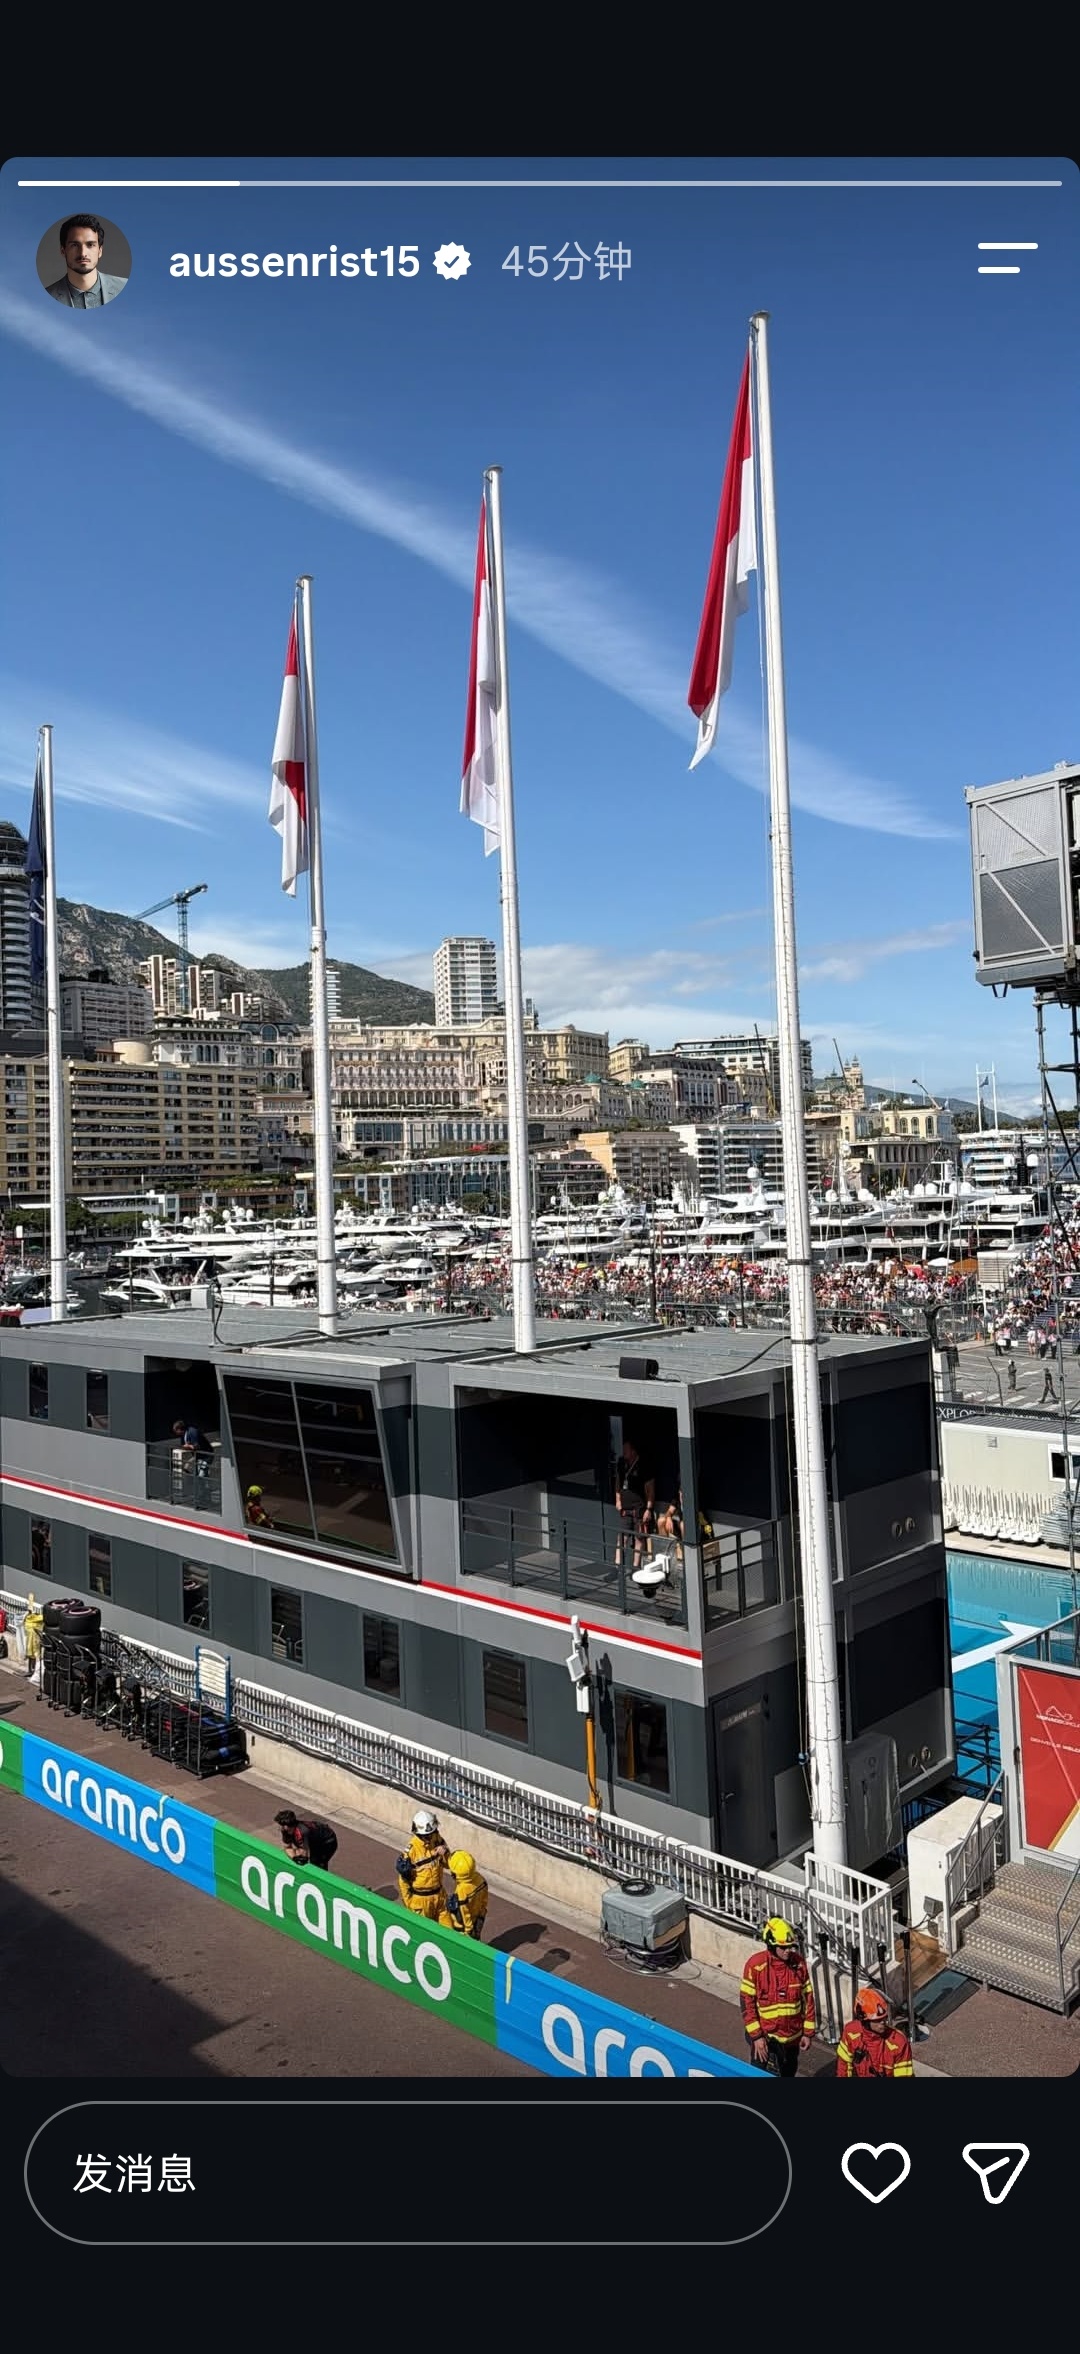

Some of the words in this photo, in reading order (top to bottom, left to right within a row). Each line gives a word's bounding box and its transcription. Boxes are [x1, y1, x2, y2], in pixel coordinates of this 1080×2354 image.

[42, 1759, 186, 1864] aramco
[241, 1856, 452, 2001] aramco
[542, 2004, 714, 2077] ara
